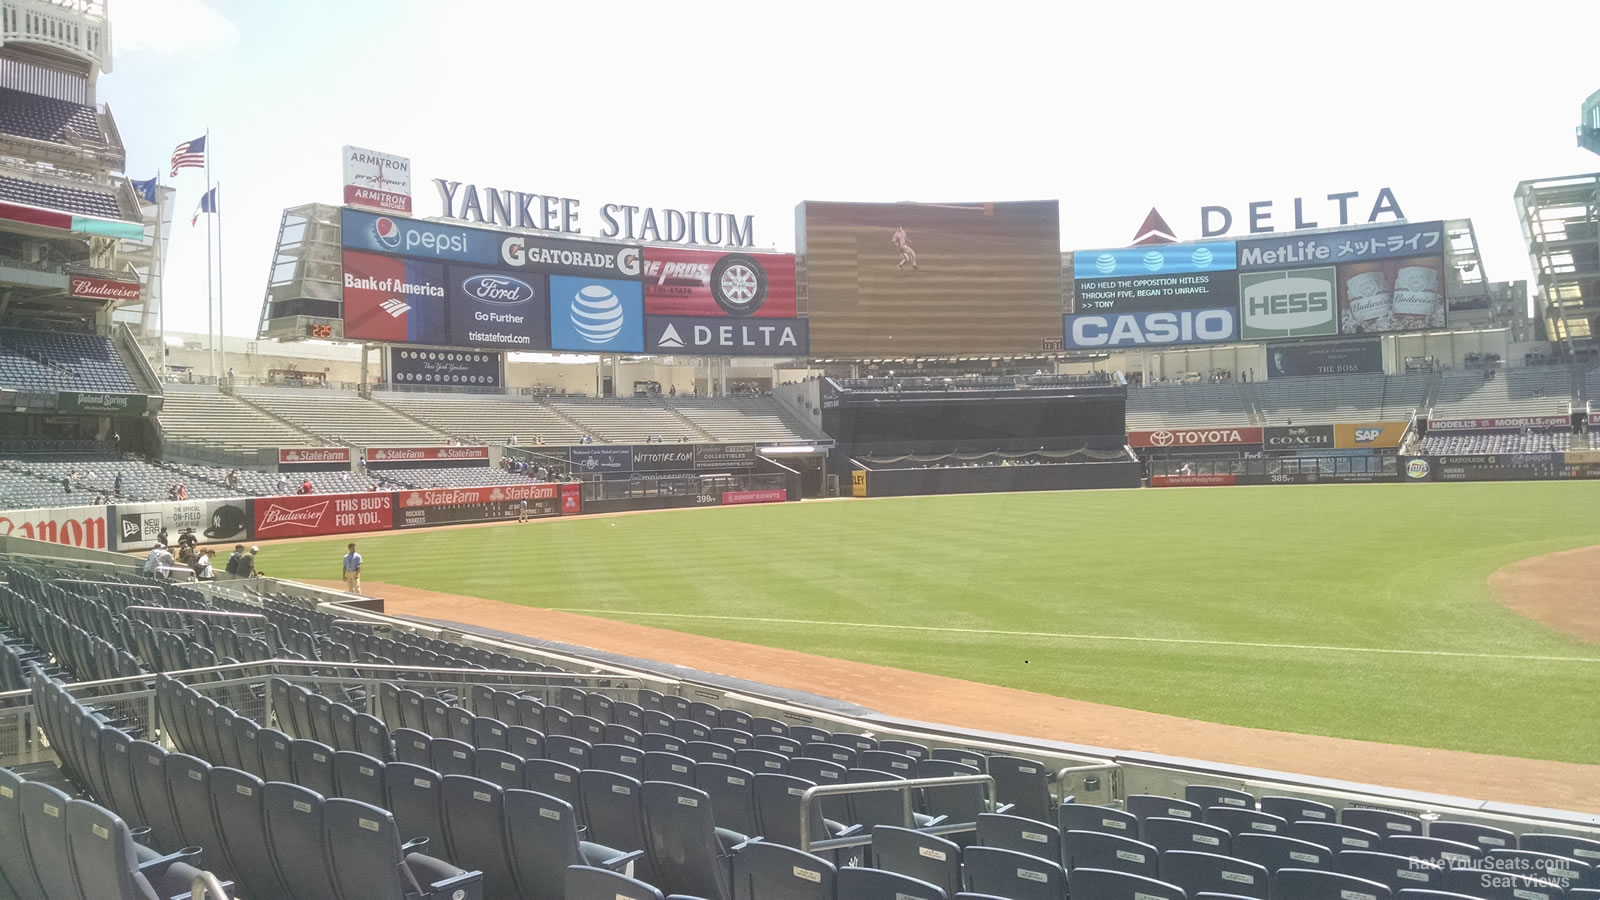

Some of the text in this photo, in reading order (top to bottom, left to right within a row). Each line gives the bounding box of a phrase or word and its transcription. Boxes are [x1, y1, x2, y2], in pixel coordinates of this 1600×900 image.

[351, 152, 408, 171] ARMITRON
[354, 189, 407, 205] ARMITRON
[431, 178, 756, 247] YANKEE STADIUM
[1201, 187, 1405, 238] DELTA
[406, 229, 467, 254] pepsi
[1241, 231, 1440, 266] MetLife メットライフ
[501, 236, 640, 276] G GATORADE G
[72, 278, 140, 298] Budweiser
[344, 273, 444, 297] Bank of America
[476, 278, 520, 301] Ford
[1081, 276, 1209, 290] HAD HELD THE OPPOSITION HITLESS
[1081, 291, 1116, 300] THROUGH
[1117, 290, 1136, 298] FIVE,
[1137, 289, 1161, 297] BEGAN
[1174, 286, 1210, 295] UNRAVEL.
[1250, 291, 1328, 316] HESS
[474, 311, 524, 324] Go Further
[1072, 309, 1233, 346] CASIO
[468, 331, 530, 344] tristateford.com
[694, 325, 798, 346] DELTA
[1318, 364, 1359, 373] THE BOSS
[78, 393, 103, 405] Poland
[104, 394, 128, 408] Spring
[1432, 420, 1477, 429] MODELL'S
[1176, 430, 1242, 444] TOYOTA
[1269, 434, 1329, 446] COACH
[1355, 430, 1380, 441] SAP
[634, 452, 692, 463] NITTOTIRE.COM
[1525, 454, 1551, 463] pepsi
[756, 492, 780, 500] DONUTS
[335, 497, 390, 511] THIS BUD'S
[144, 518, 160, 527] NEW
[173, 512, 201, 521] ON-FIELD
[264, 509, 322, 523] Budweiser
[336, 512, 381, 526] FOR YOU.
[144, 526, 160, 535] ERA
